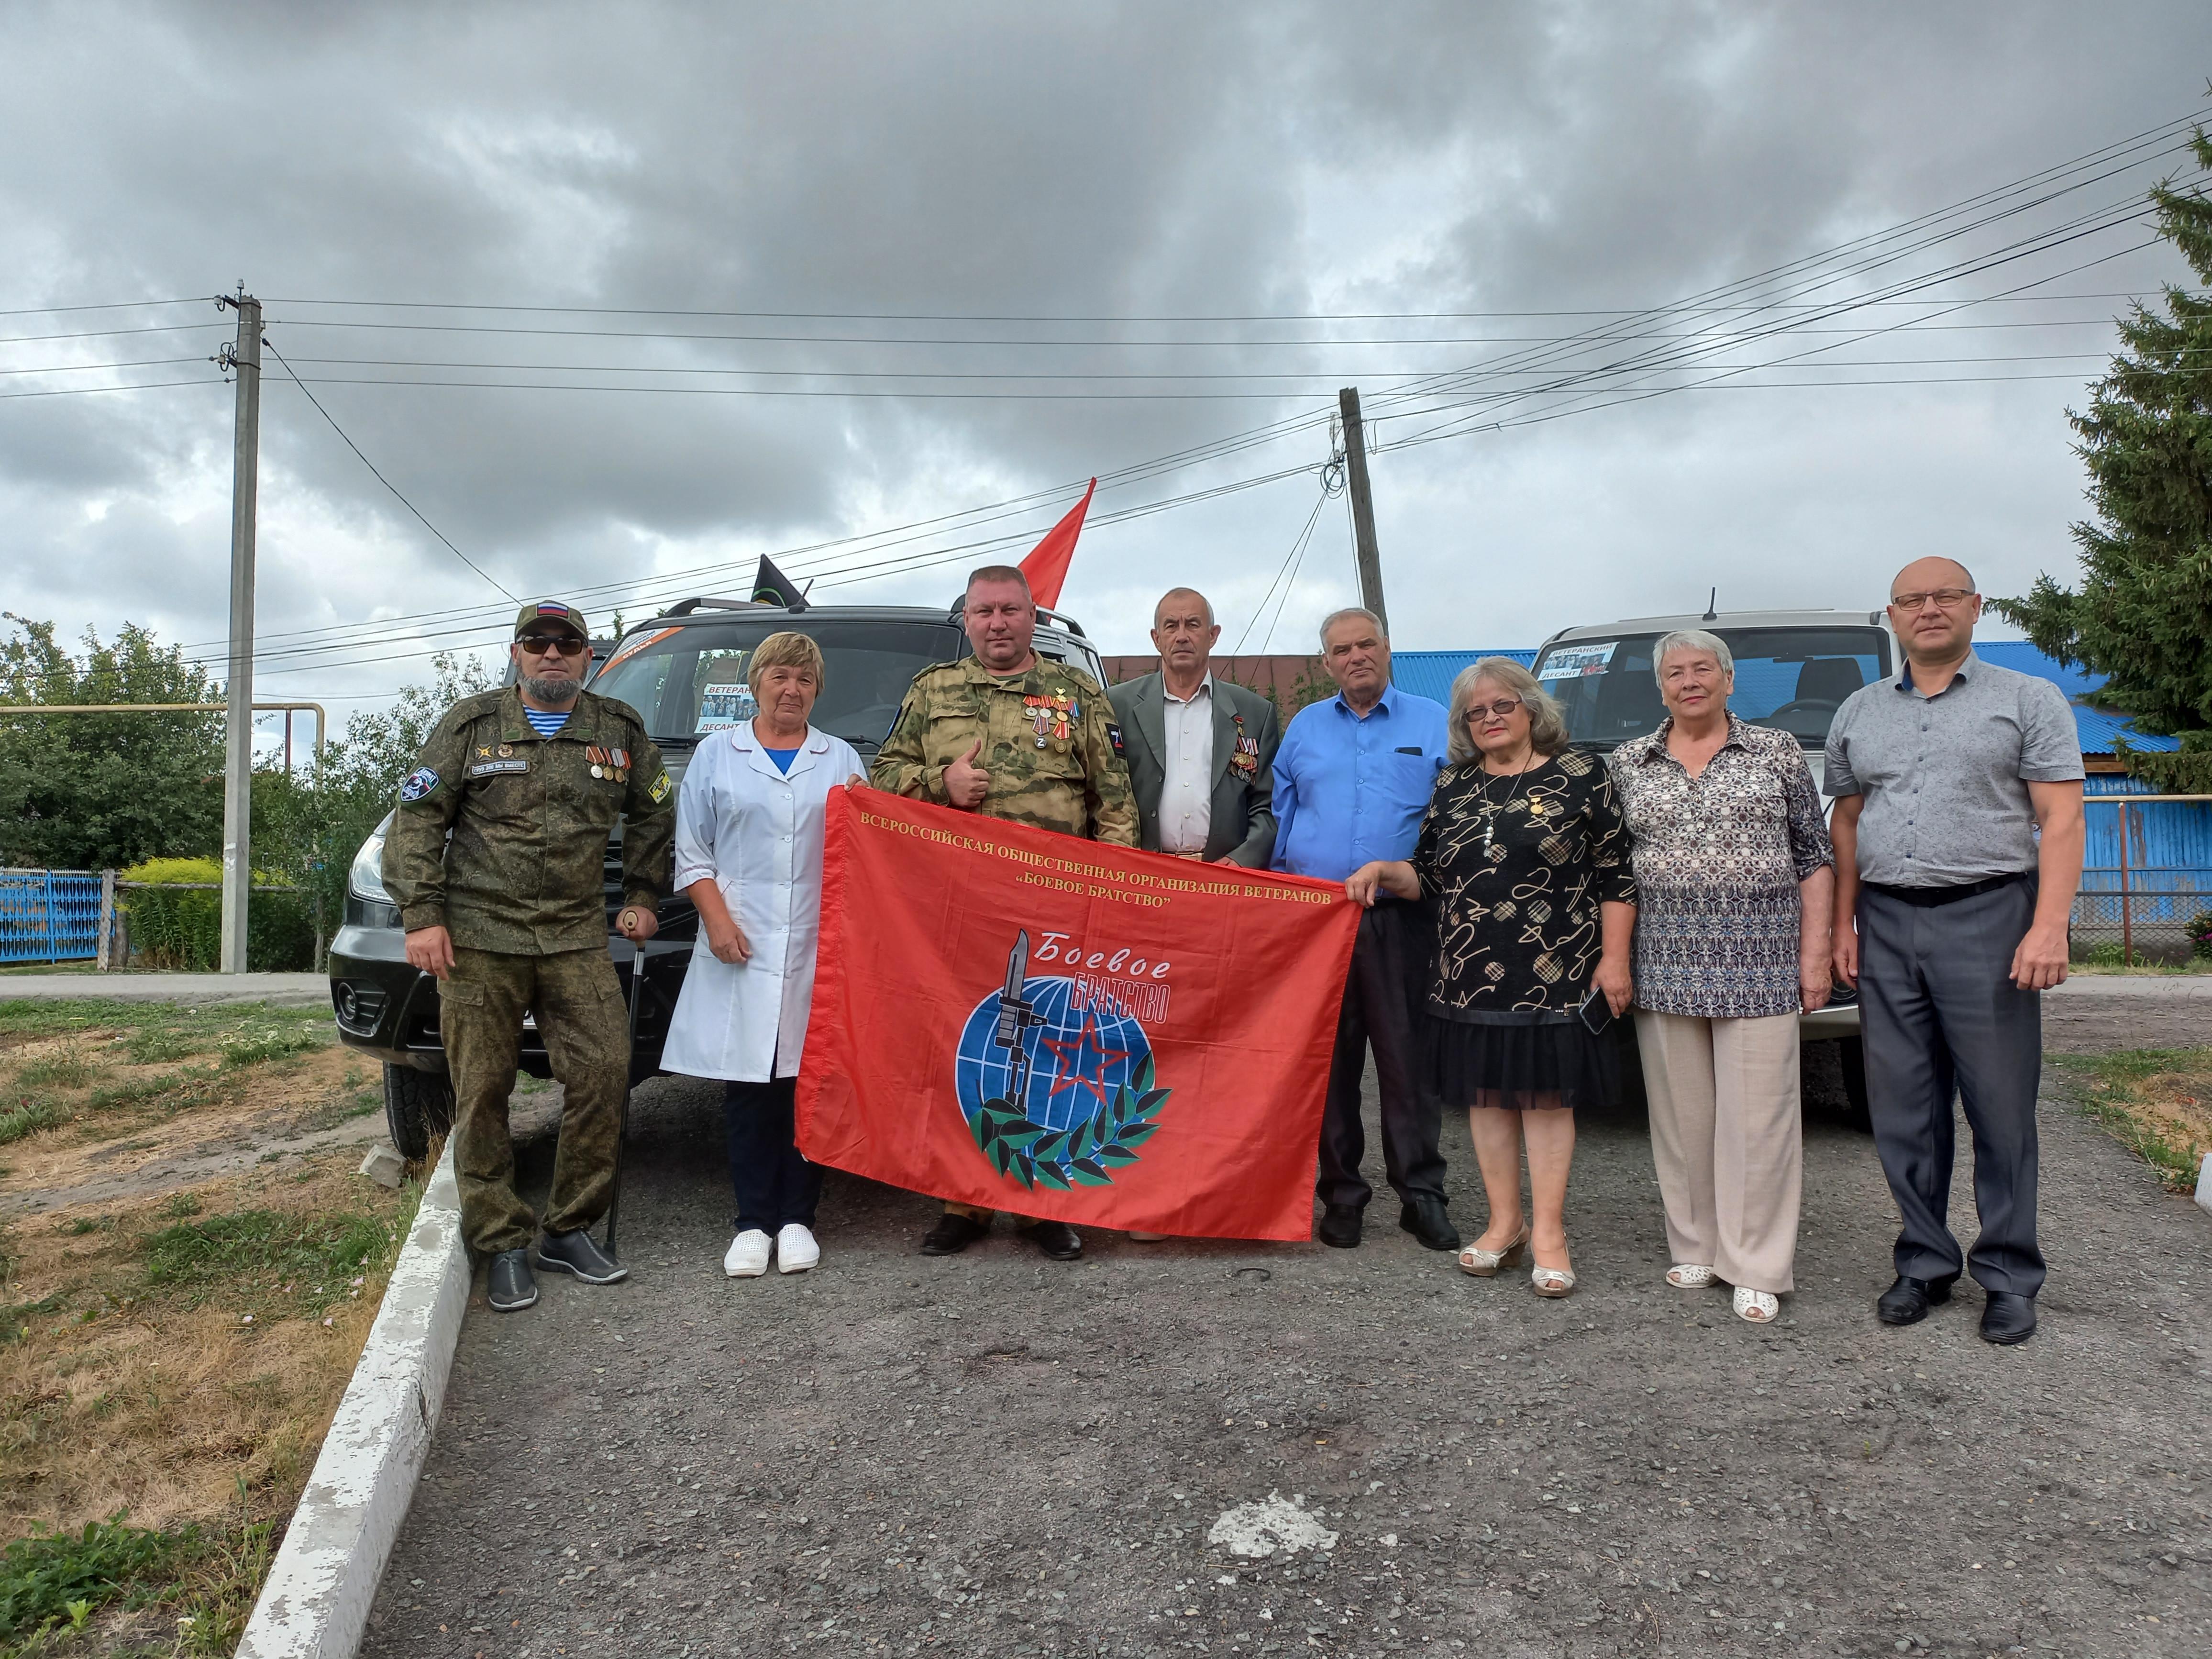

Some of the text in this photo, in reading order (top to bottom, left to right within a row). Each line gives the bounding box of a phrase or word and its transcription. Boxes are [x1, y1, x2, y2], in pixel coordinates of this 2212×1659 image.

[622, 641, 653, 659] СУДЬЯ
[1542, 671, 1577, 679] ДЕСАНТ
[1037, 738, 1044, 746] Z
[861, 811, 1331, 905] ВСЕРОССИЙСКАЯ ОБЩЕСТВЕННАЯ ОРГАНИЗАЦИЯ ВЕТЕРАНОВ
[1034, 931, 1171, 979] Боевое
[1070, 971, 1171, 1025] БРАТСТВО
